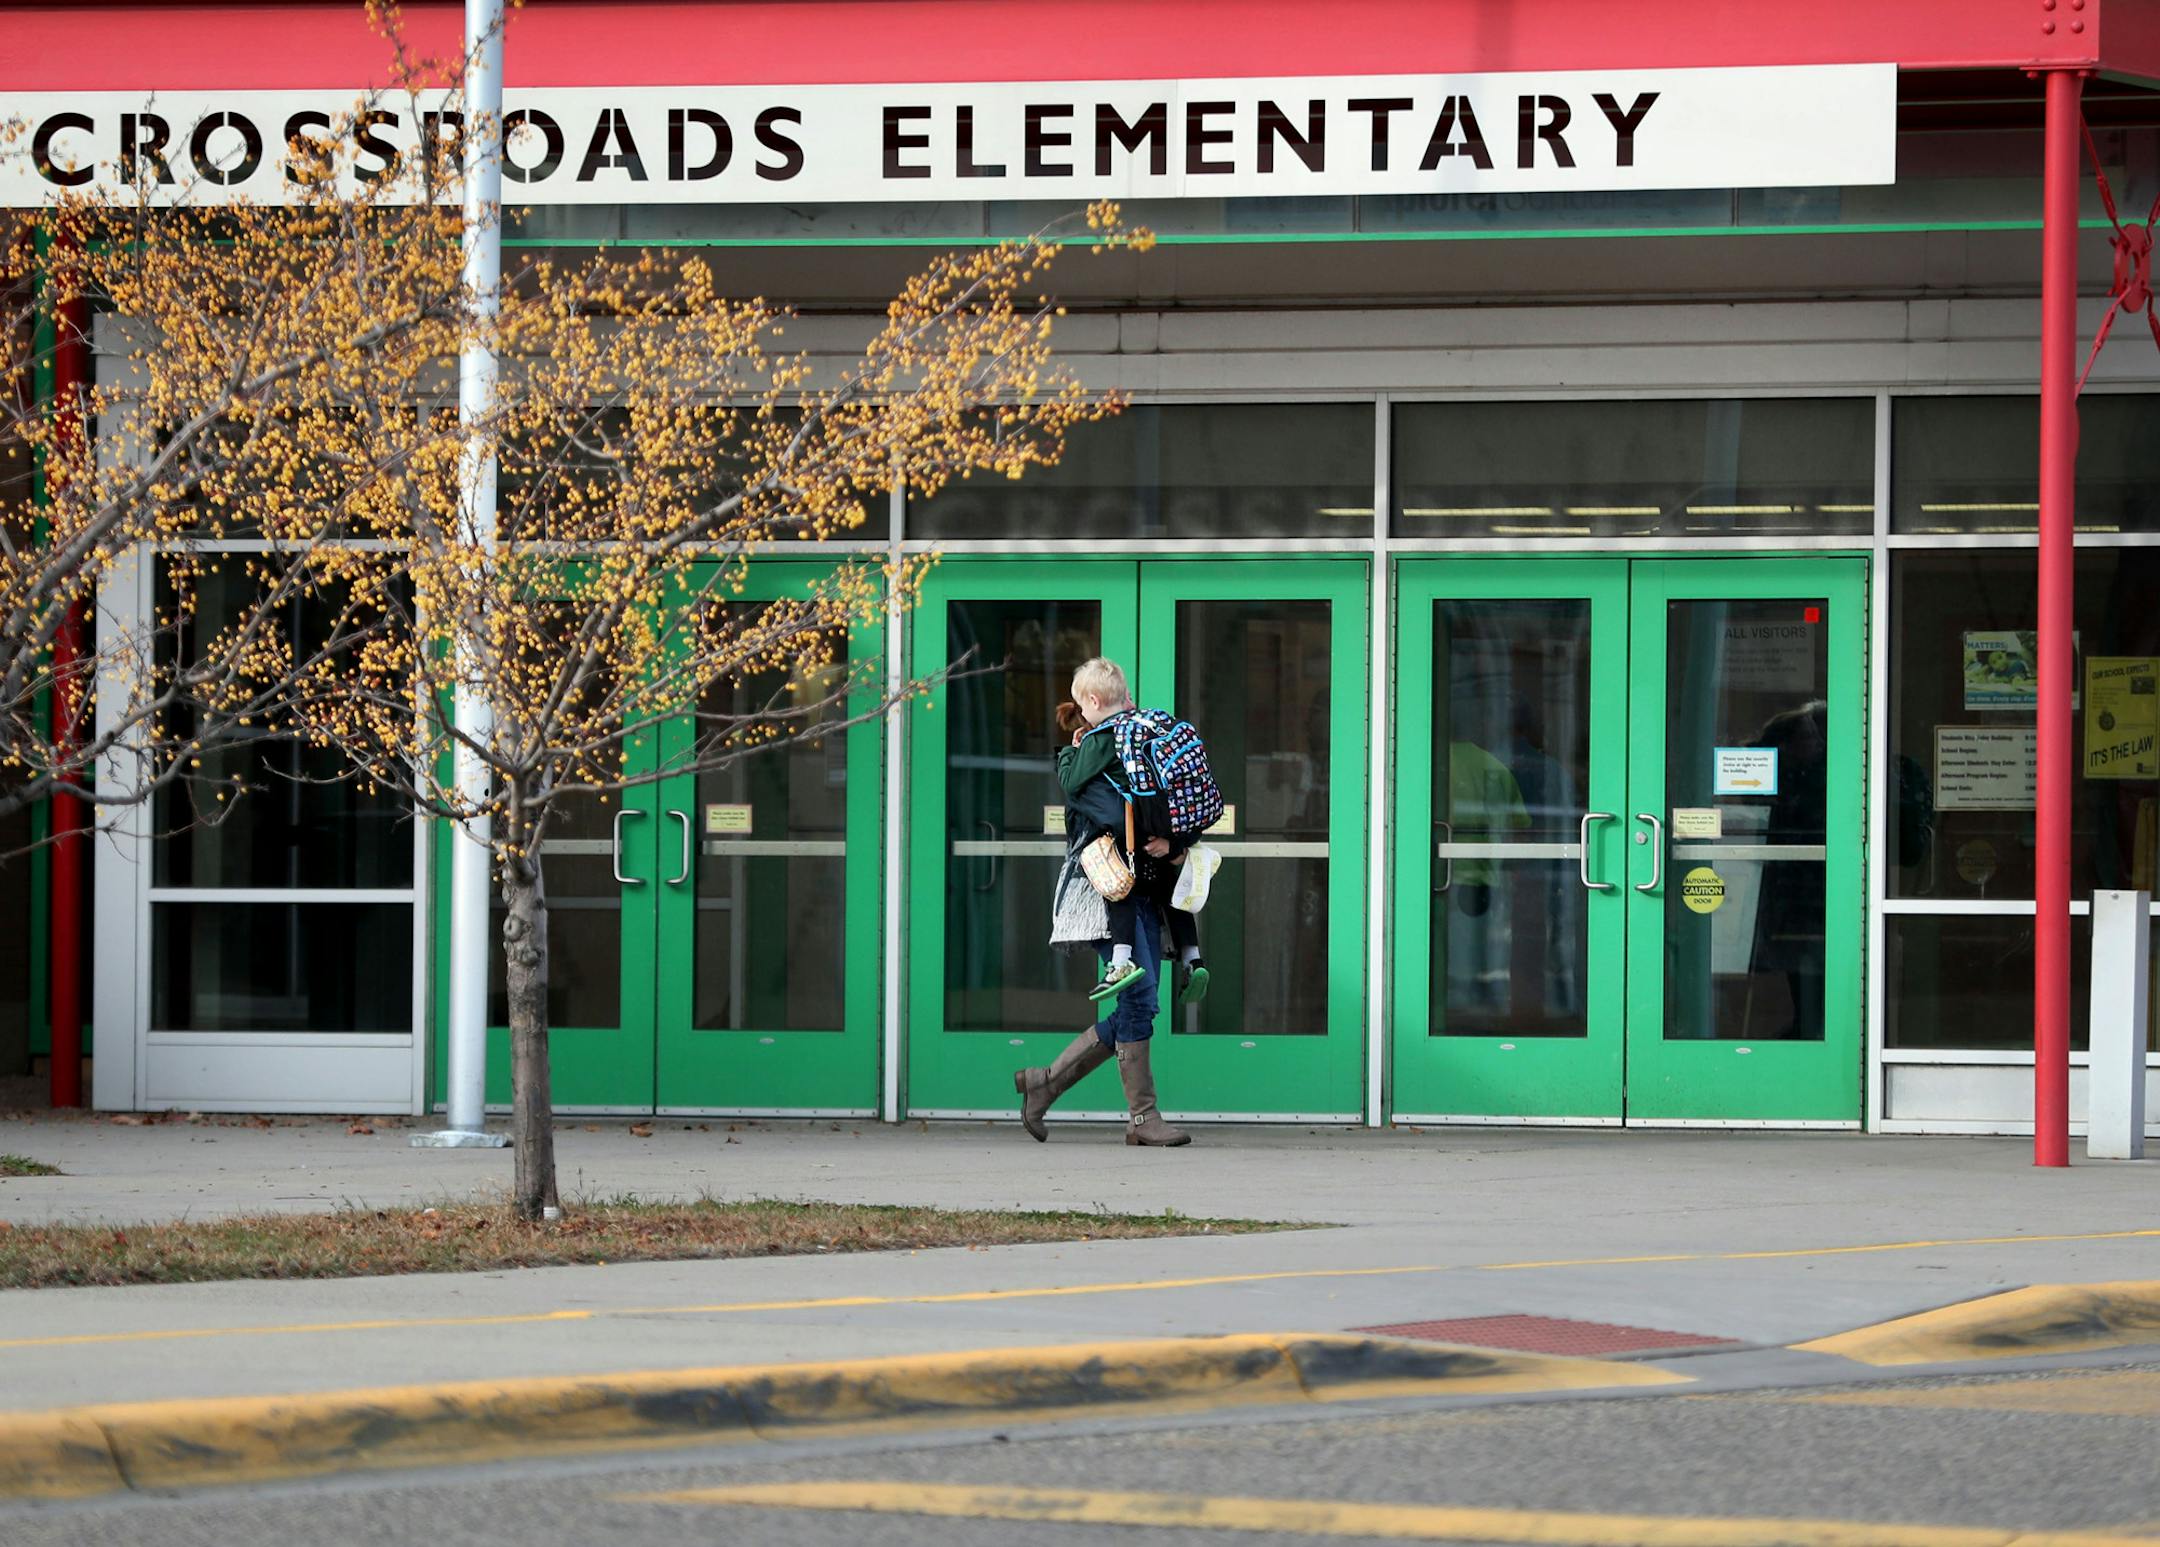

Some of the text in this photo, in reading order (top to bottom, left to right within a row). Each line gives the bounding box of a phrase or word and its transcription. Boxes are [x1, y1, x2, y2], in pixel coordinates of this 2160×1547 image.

[32, 92, 1662, 187] CROSSROADS ELEMENTARY
[1725, 625, 1808, 640] ALL VISITORS
[2090, 735, 2154, 767] IT'S THE LAW
[1683, 886, 1723, 895] CAUTION
